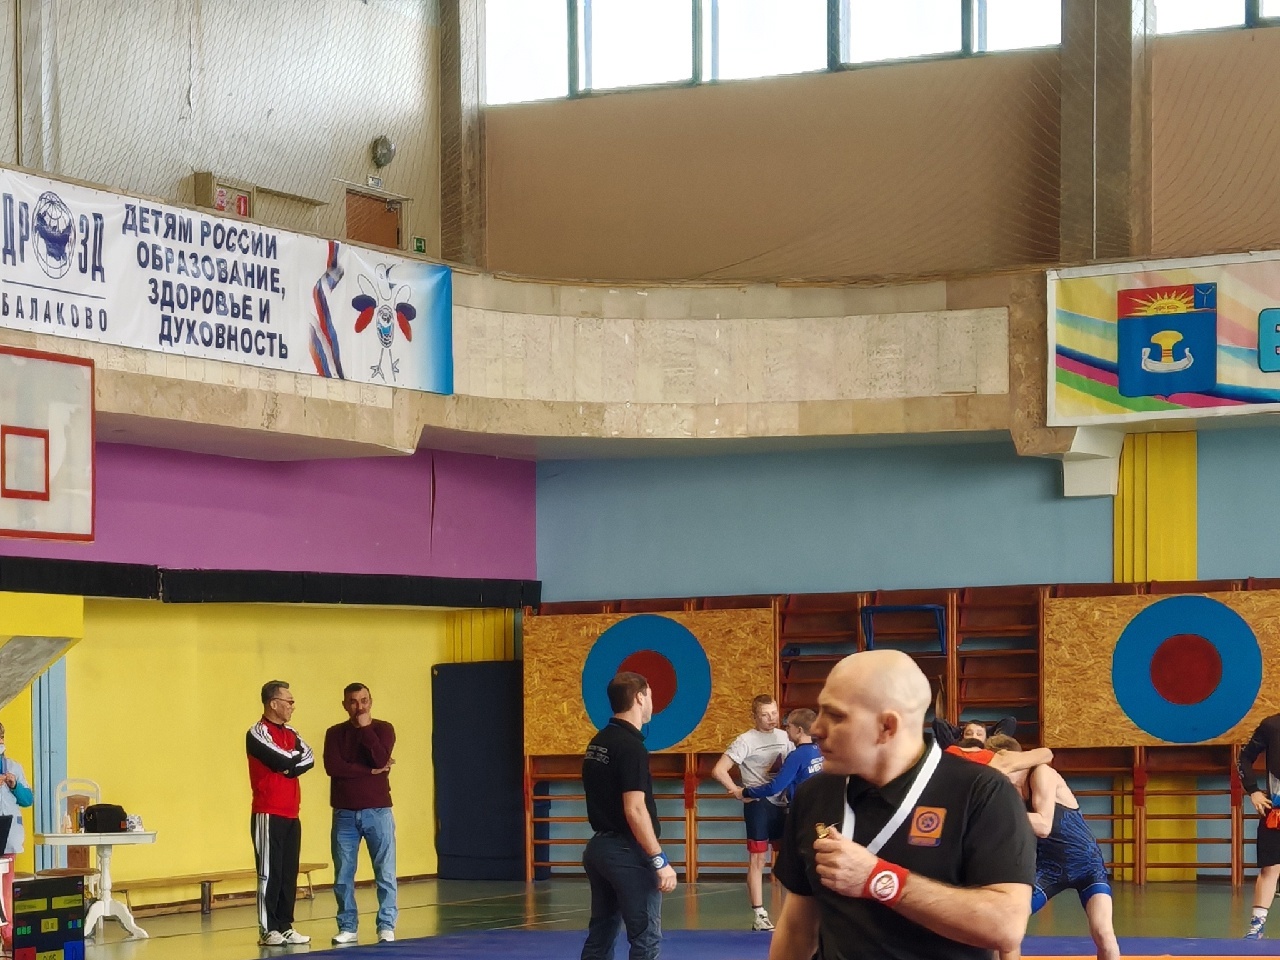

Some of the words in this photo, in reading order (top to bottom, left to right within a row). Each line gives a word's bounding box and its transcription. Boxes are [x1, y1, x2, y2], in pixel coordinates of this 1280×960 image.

[122, 203, 193, 244] ДЕТЯМ
[200, 220, 278, 260] РОССИИ
[136, 240, 286, 301] ОБРАЗОВАНИЕ,
[1, 292, 108, 333] БАЛАКОВО
[148, 277, 253, 321] ЗДОРОВЬЕ
[258, 298, 271, 324] И
[159, 314, 289, 359] ДУХОВНОСТЬ
